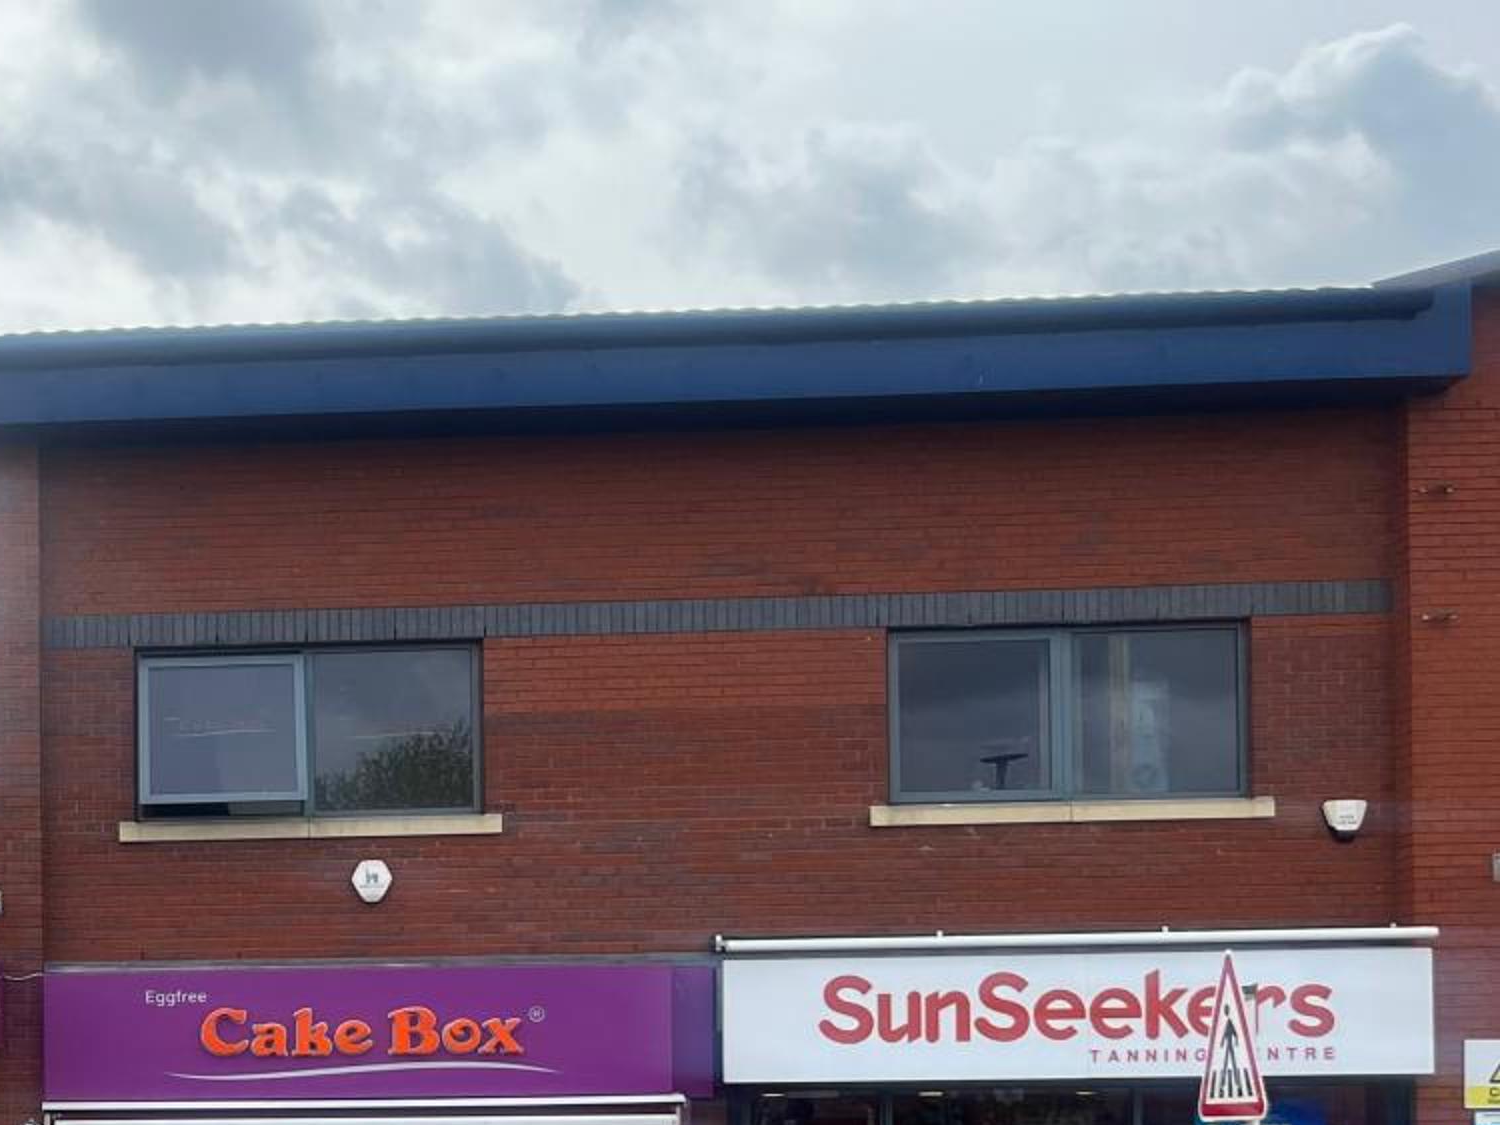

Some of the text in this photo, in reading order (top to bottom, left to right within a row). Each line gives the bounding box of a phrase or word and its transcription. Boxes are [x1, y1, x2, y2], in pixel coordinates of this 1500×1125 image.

[144, 989, 208, 1007] Eggfree
[818, 968, 1336, 1045] SunSeekers
[200, 1005, 525, 1058] Cake Box
[1090, 1046, 1336, 1063] TANNING NTRE
